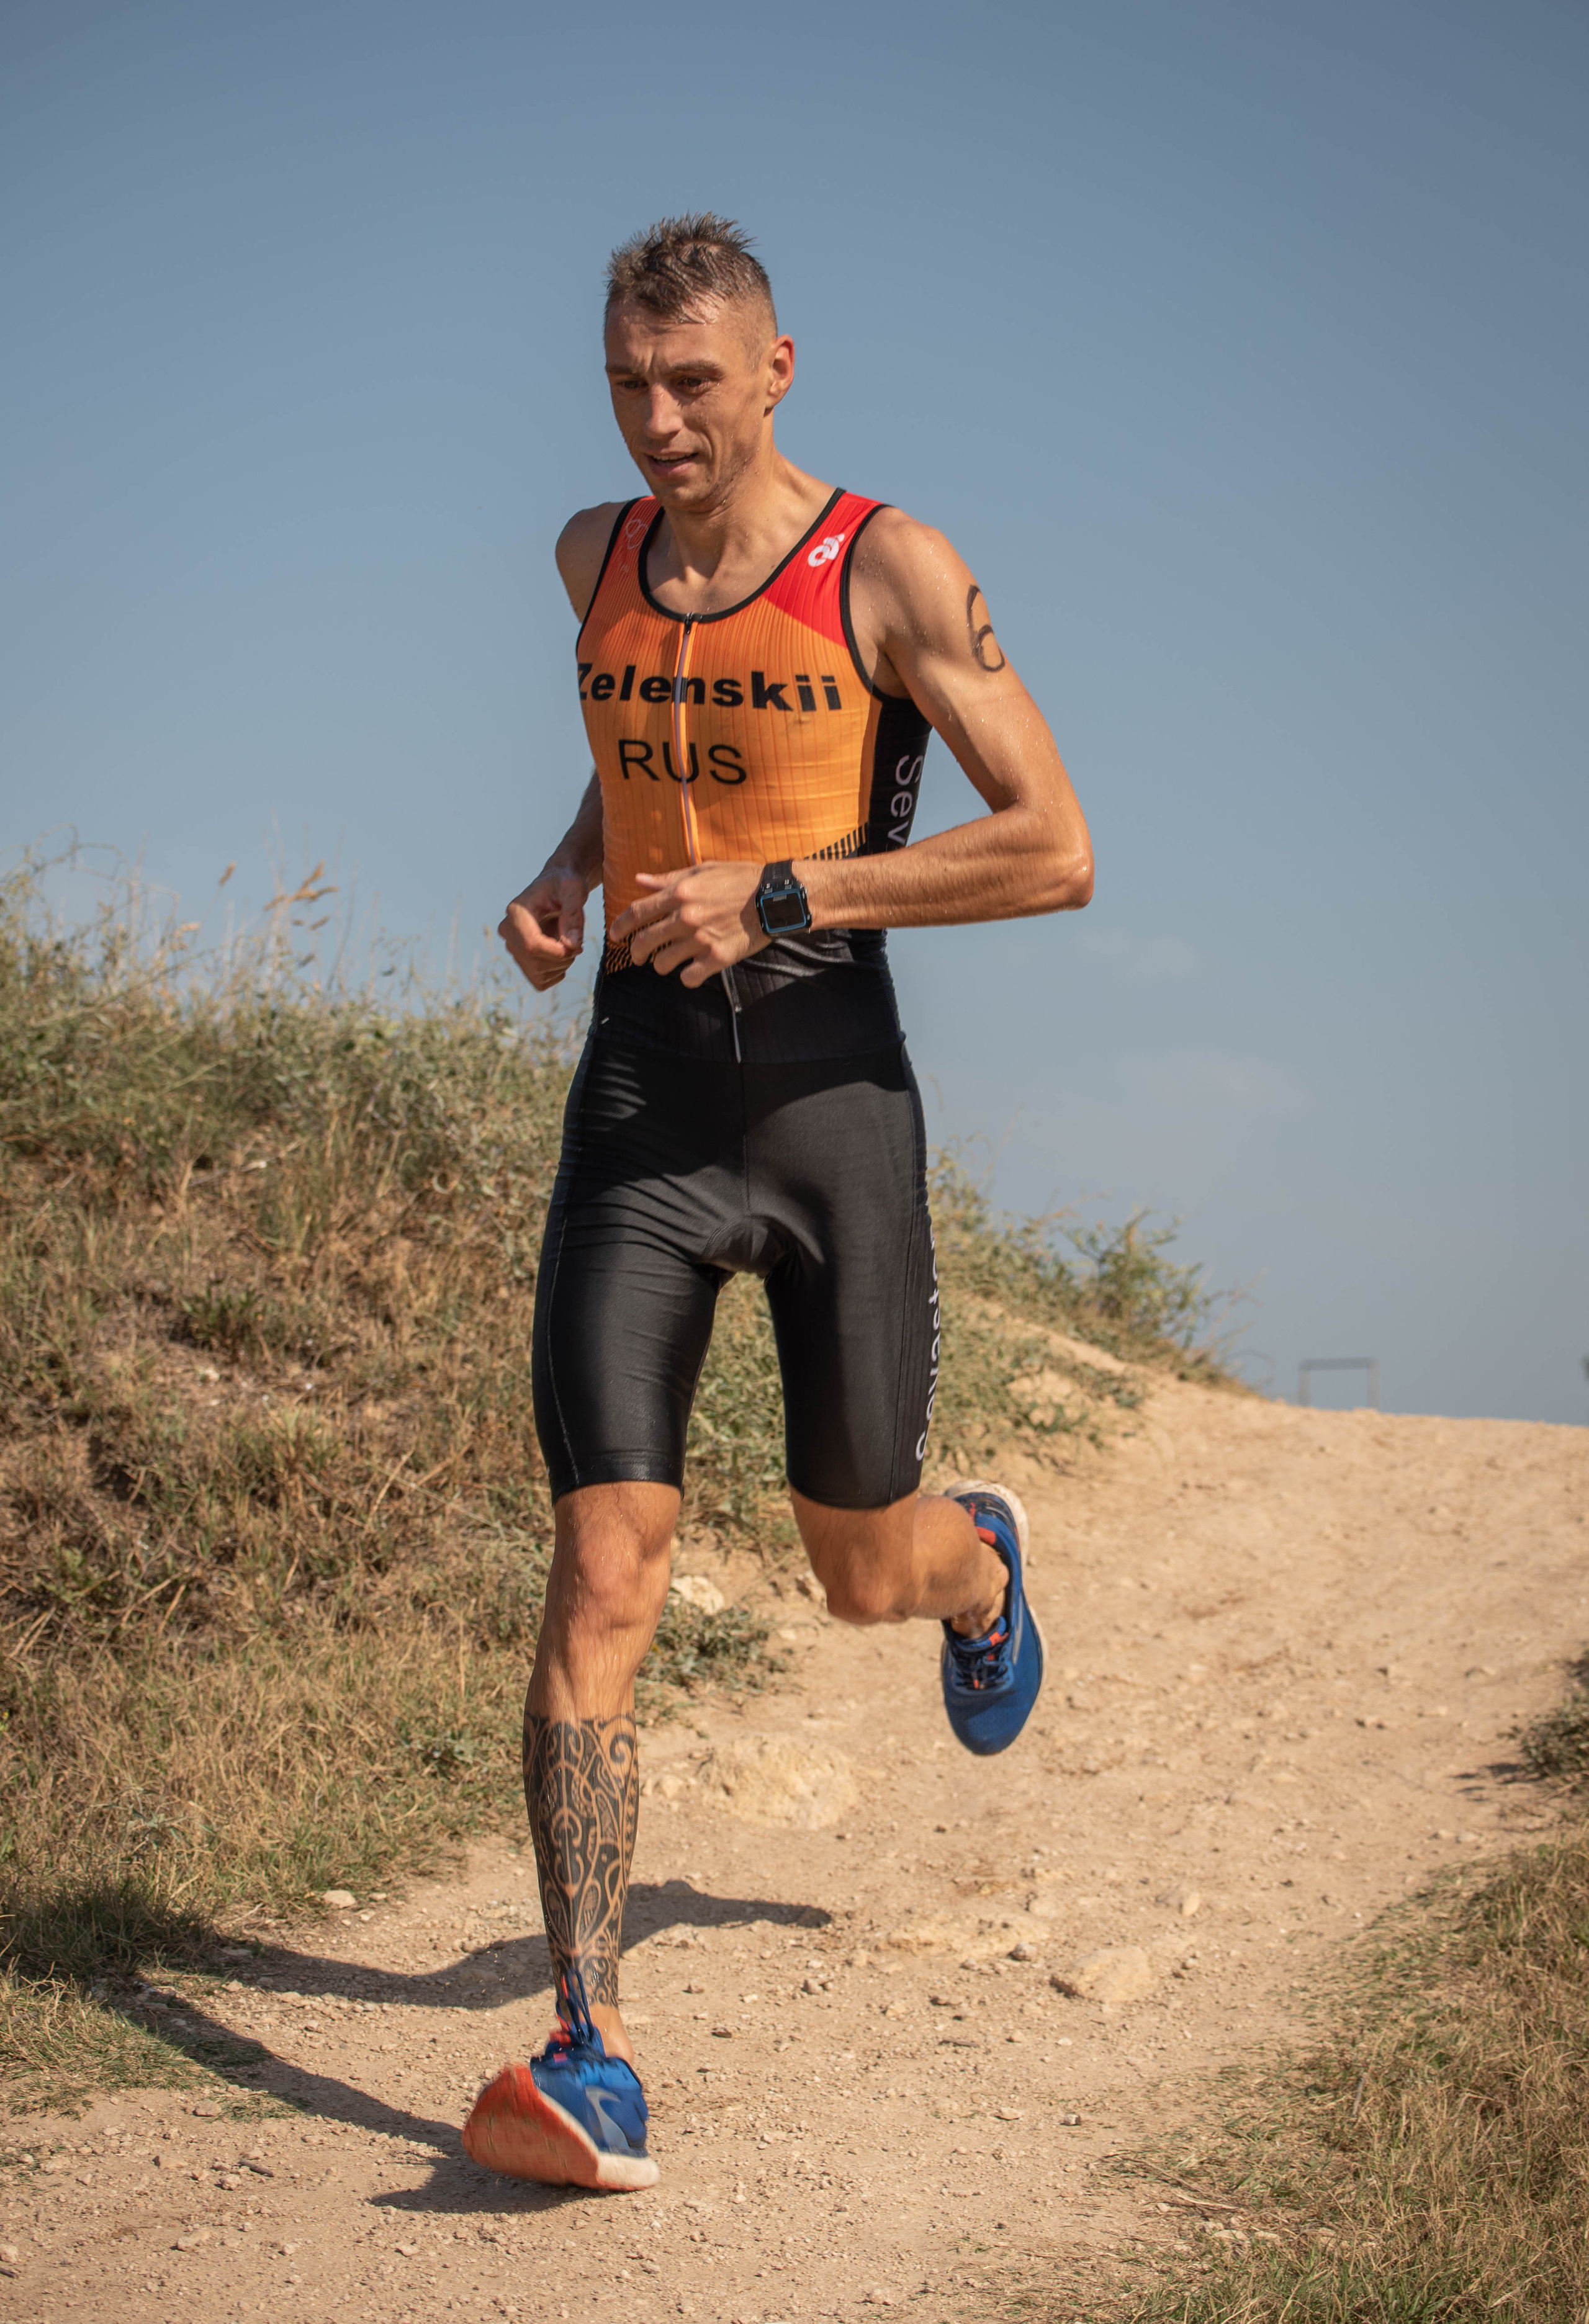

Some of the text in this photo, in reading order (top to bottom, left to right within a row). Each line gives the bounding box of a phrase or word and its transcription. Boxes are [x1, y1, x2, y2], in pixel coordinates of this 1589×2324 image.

[966, 584, 1006, 673] 6
[577, 662, 842, 712] Zelenskii
[618, 738, 747, 785] RUS
